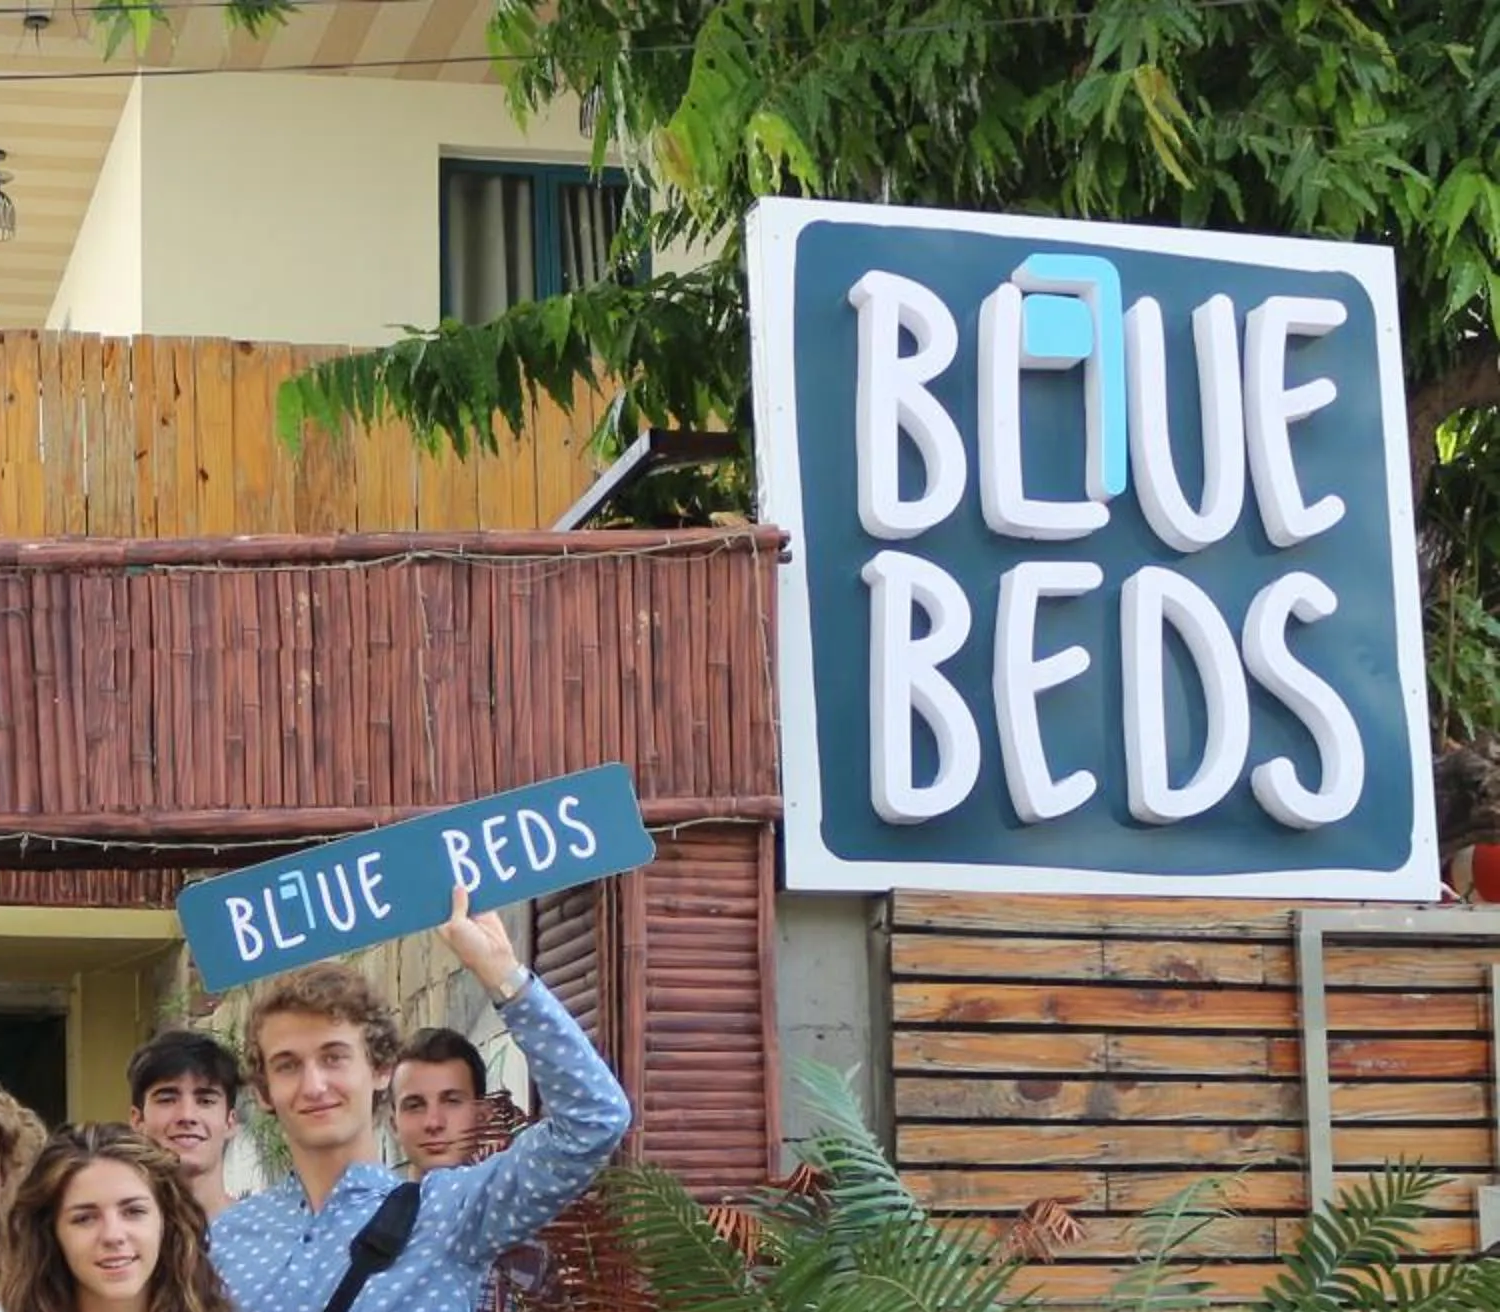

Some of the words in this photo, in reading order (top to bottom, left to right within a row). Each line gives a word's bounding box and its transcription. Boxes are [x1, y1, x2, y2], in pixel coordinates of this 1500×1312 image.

[849, 254, 1347, 552] BLUE
[862, 550, 1364, 829] BEDS
[225, 851, 391, 962] BLUE
[441, 795, 597, 893] BEDS
